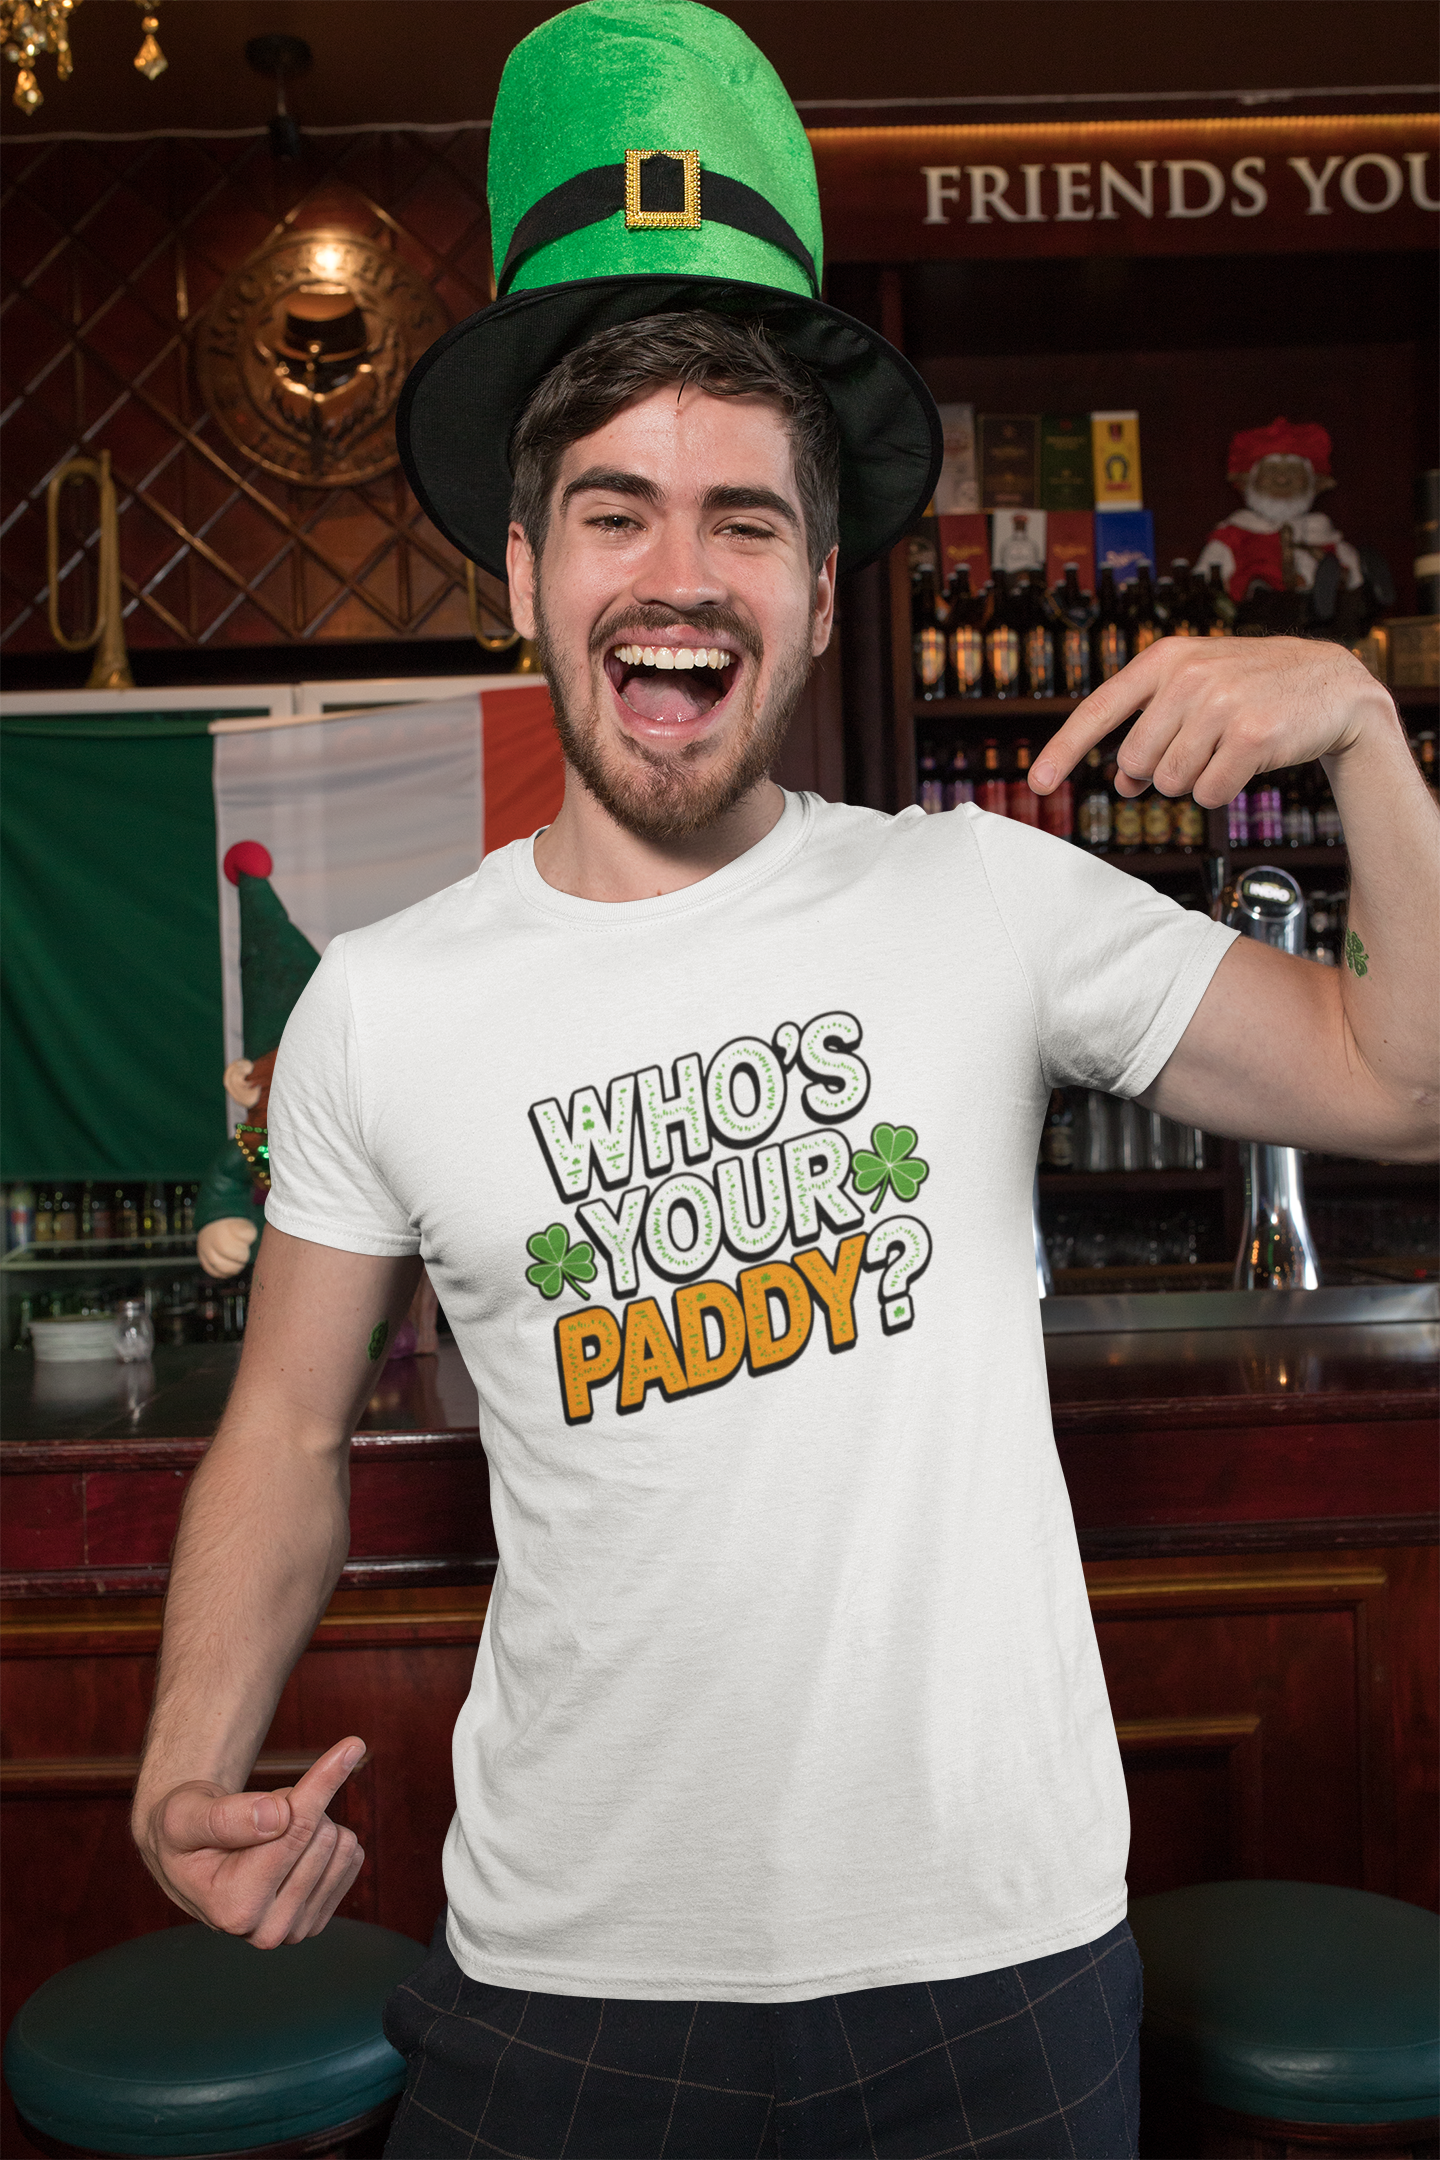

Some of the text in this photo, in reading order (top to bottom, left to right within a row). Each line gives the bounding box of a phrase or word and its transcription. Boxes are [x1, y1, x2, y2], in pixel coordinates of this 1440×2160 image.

[920, 156, 1269, 225] FRIENDS
[528, 1011, 871, 1204] WHO'S
[576, 1127, 865, 1300] YOUR
[554, 1214, 933, 1427] PADDY?
